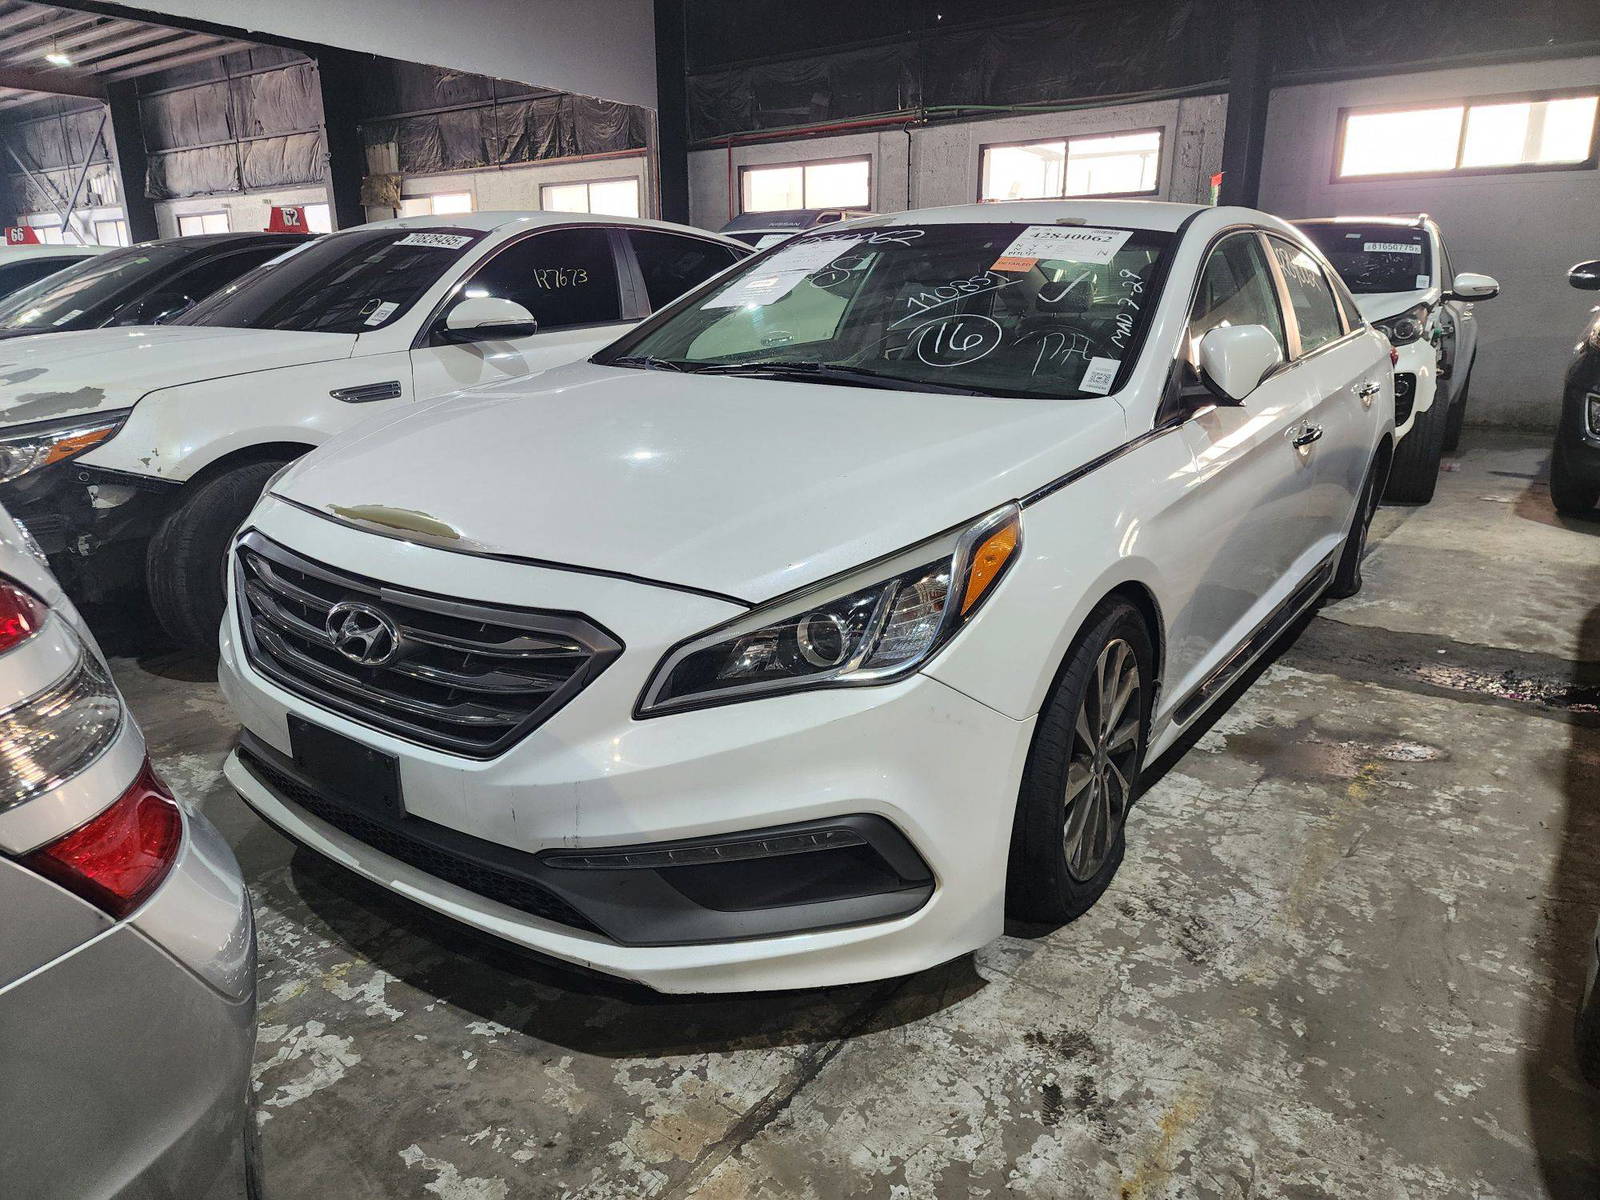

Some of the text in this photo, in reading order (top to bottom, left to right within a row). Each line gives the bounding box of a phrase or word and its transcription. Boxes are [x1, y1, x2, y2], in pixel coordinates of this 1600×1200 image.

[11, 227, 24, 242] 66
[1032, 231, 1113, 243] 42840062
[533, 267, 588, 290] R7673
[934, 322, 983, 353] 16
